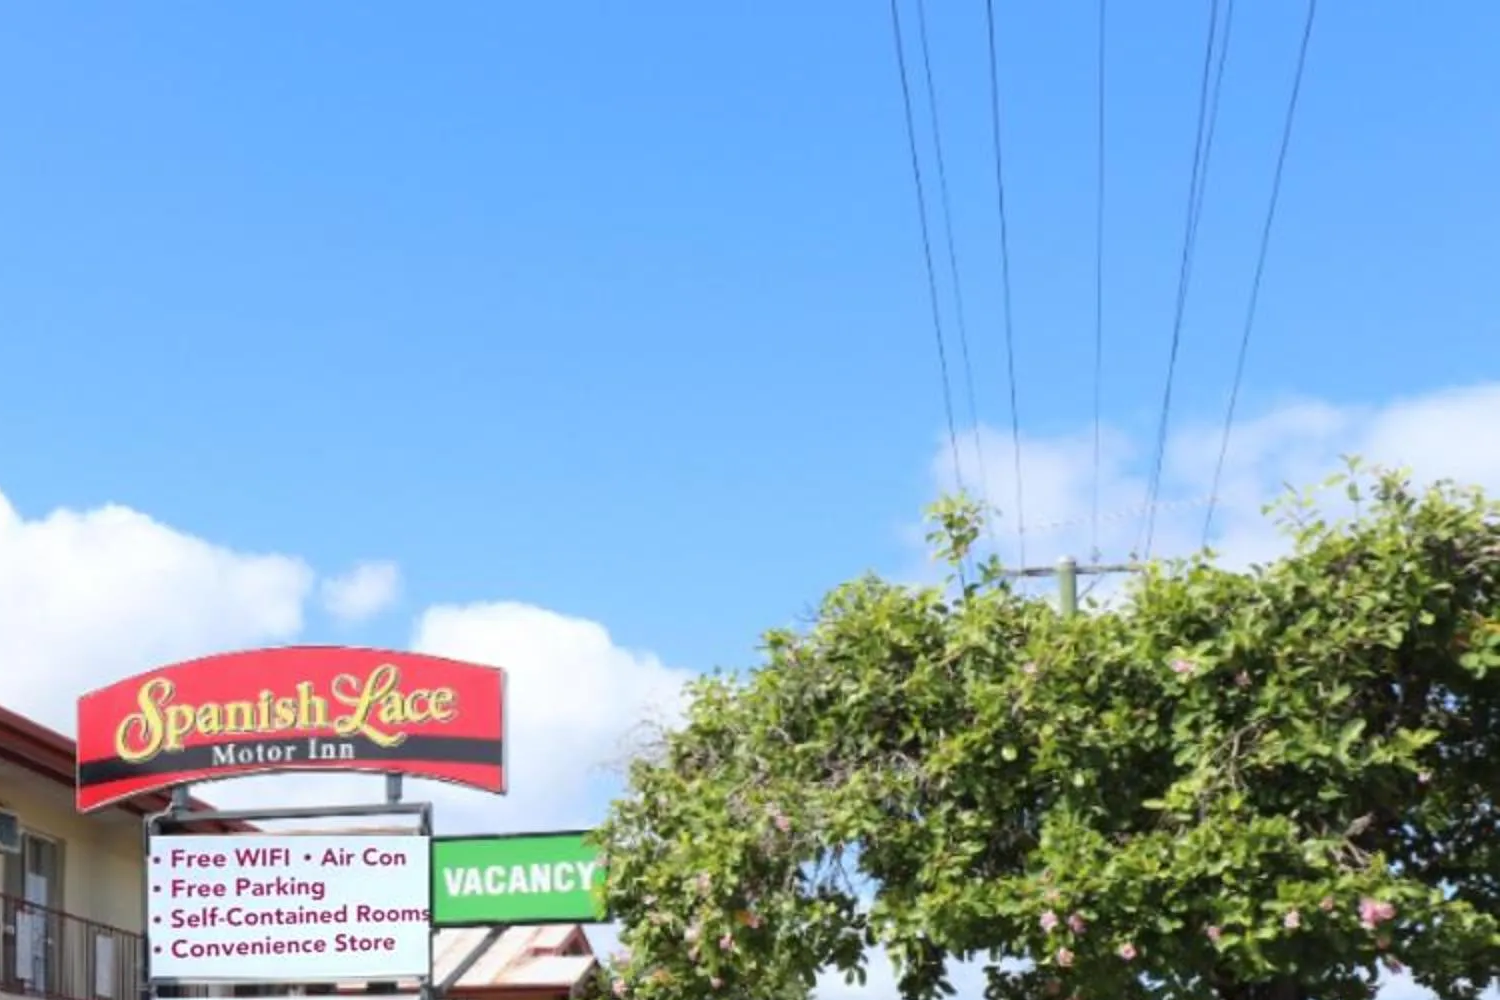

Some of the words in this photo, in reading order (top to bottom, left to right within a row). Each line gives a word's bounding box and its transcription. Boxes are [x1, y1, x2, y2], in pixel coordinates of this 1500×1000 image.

[116, 677, 331, 762] Spanish
[332, 663, 455, 747] Lace
[212, 744, 297, 766] Motor
[308, 738, 356, 760] Inn
[171, 849, 227, 868] Free
[234, 848, 290, 867] WIFI
[321, 848, 355, 866] Air
[362, 847, 406, 866] Con
[171, 879, 227, 898] Free
[235, 876, 325, 901] Parking
[444, 861, 595, 896] VACANCY
[171, 907, 348, 929] Self-Contained
[356, 905, 431, 925] Rooms
[171, 936, 327, 959] Convenience
[335, 933, 395, 953] Store
